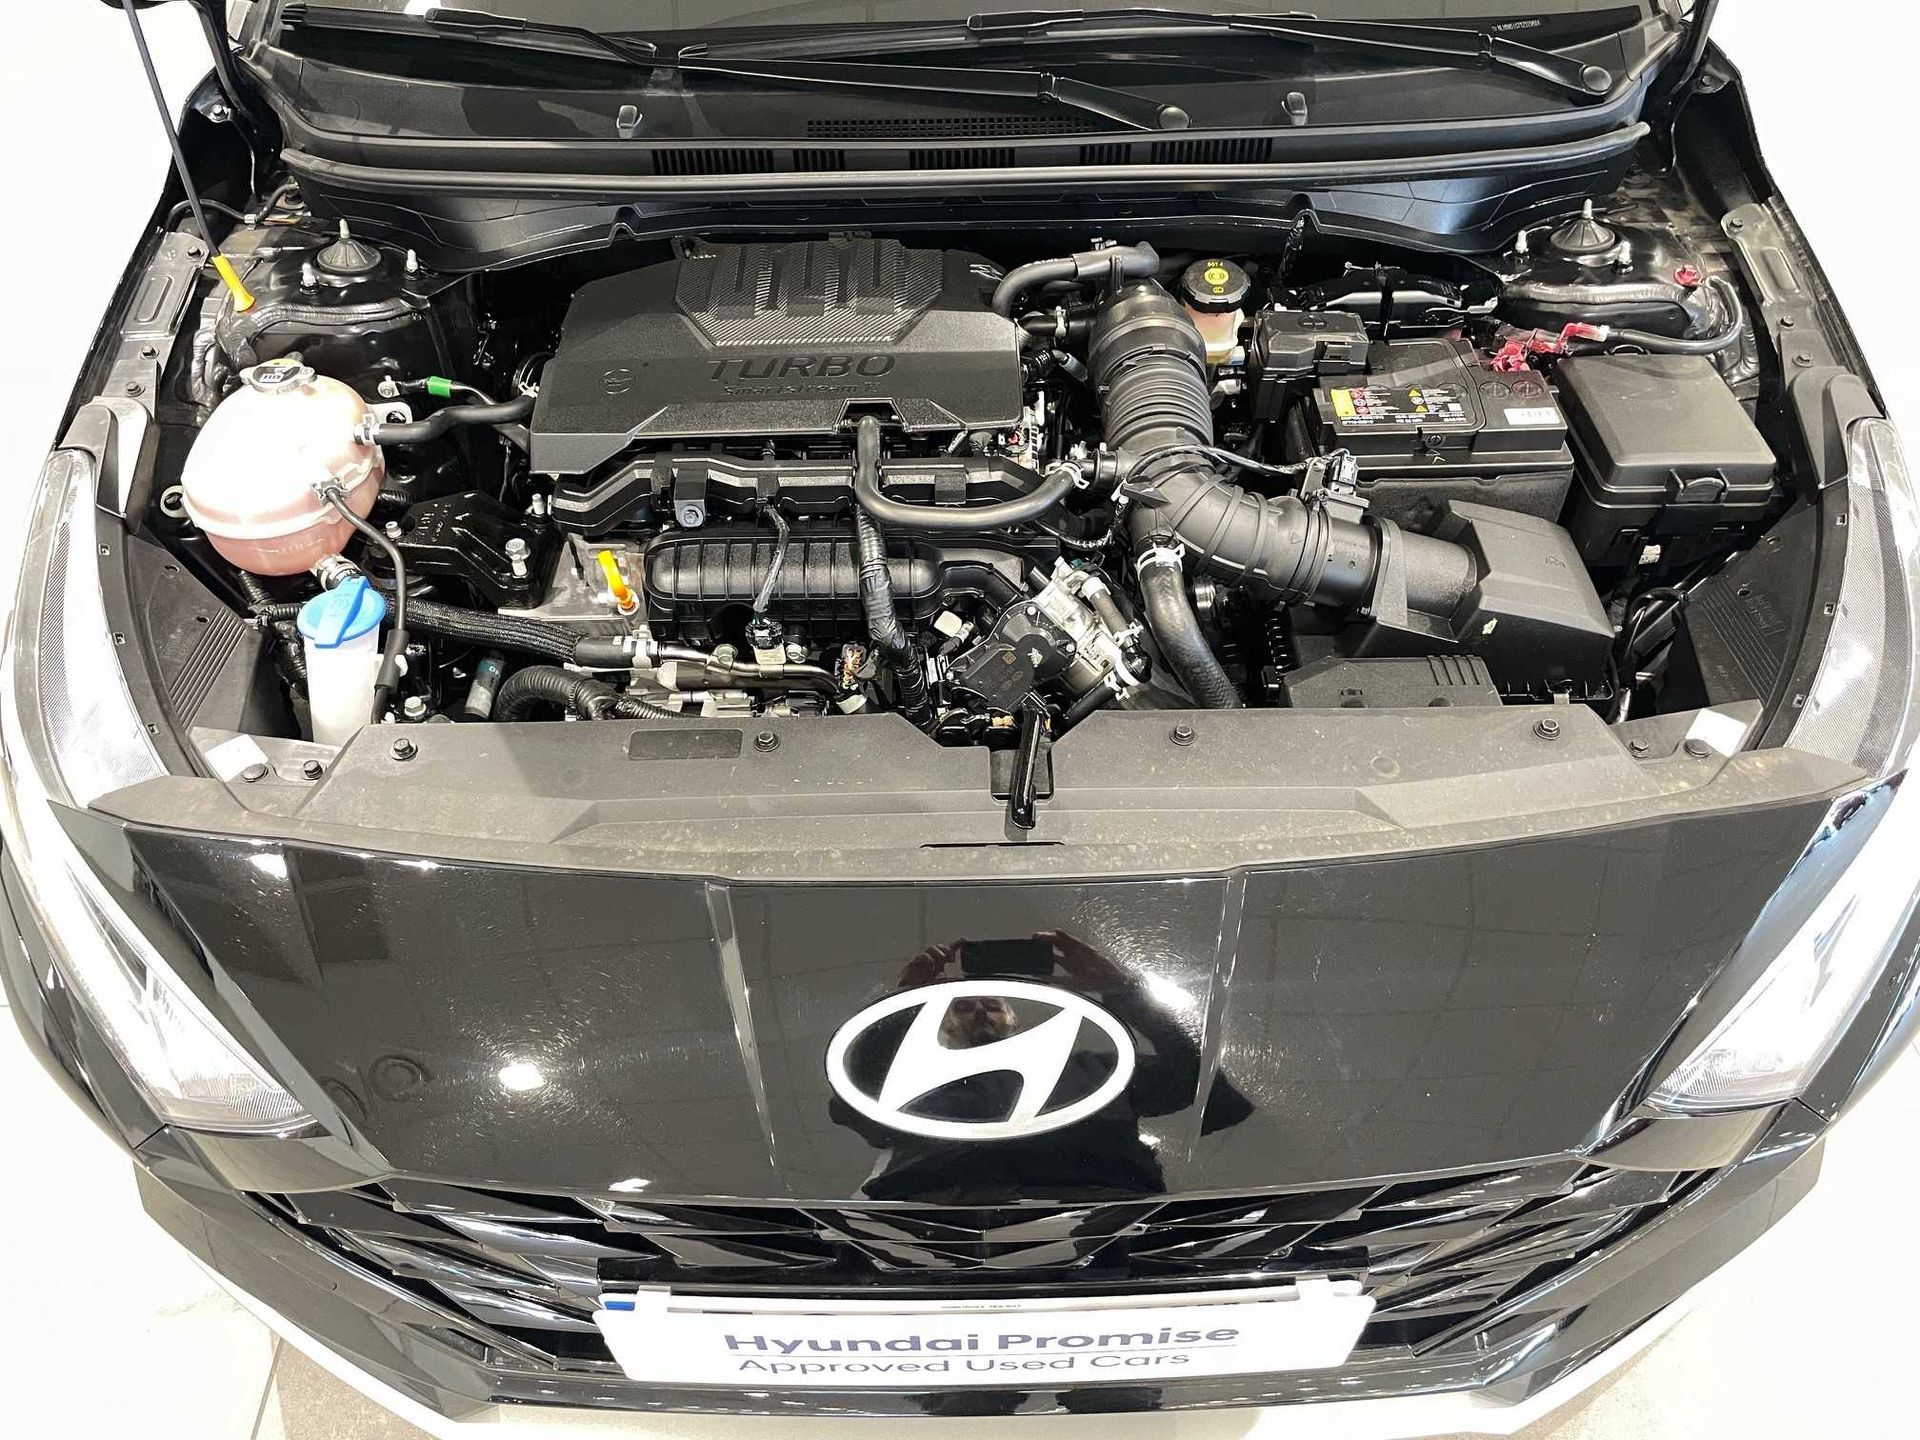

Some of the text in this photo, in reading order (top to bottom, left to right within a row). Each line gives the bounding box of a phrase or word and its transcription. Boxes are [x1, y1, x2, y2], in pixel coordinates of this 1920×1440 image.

[707, 354, 896, 382] TURBO
[724, 1327, 1240, 1355] Hyundai Promise
[739, 1354, 1190, 1375] Approved Used Cars
